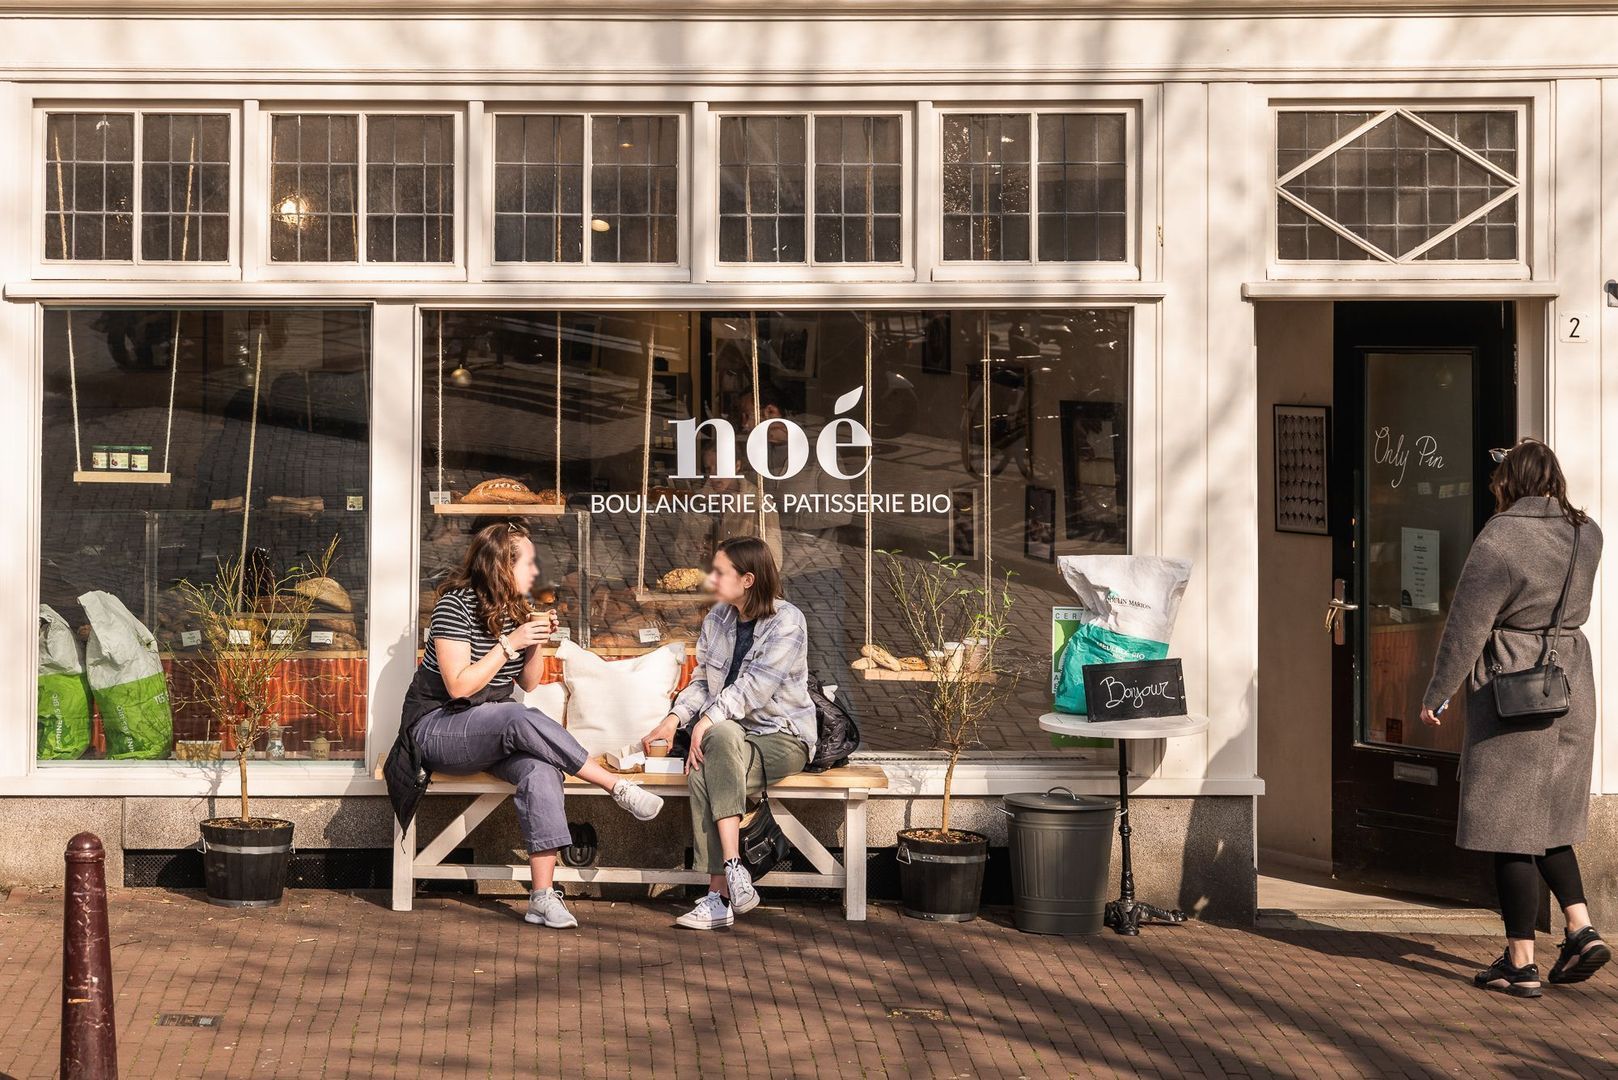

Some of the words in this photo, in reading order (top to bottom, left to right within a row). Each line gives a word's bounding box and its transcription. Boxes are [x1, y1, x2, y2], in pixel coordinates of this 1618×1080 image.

[1569, 317, 1580, 338] 2
[668, 385, 873, 480] noé
[1374, 426, 1409, 488] Only
[1415, 435, 1445, 469] Pin
[590, 493, 755, 514] BOULANGERIE
[761, 493, 777, 514] &
[784, 493, 905, 514] PATISSERIE
[911, 493, 951, 514] BIO
